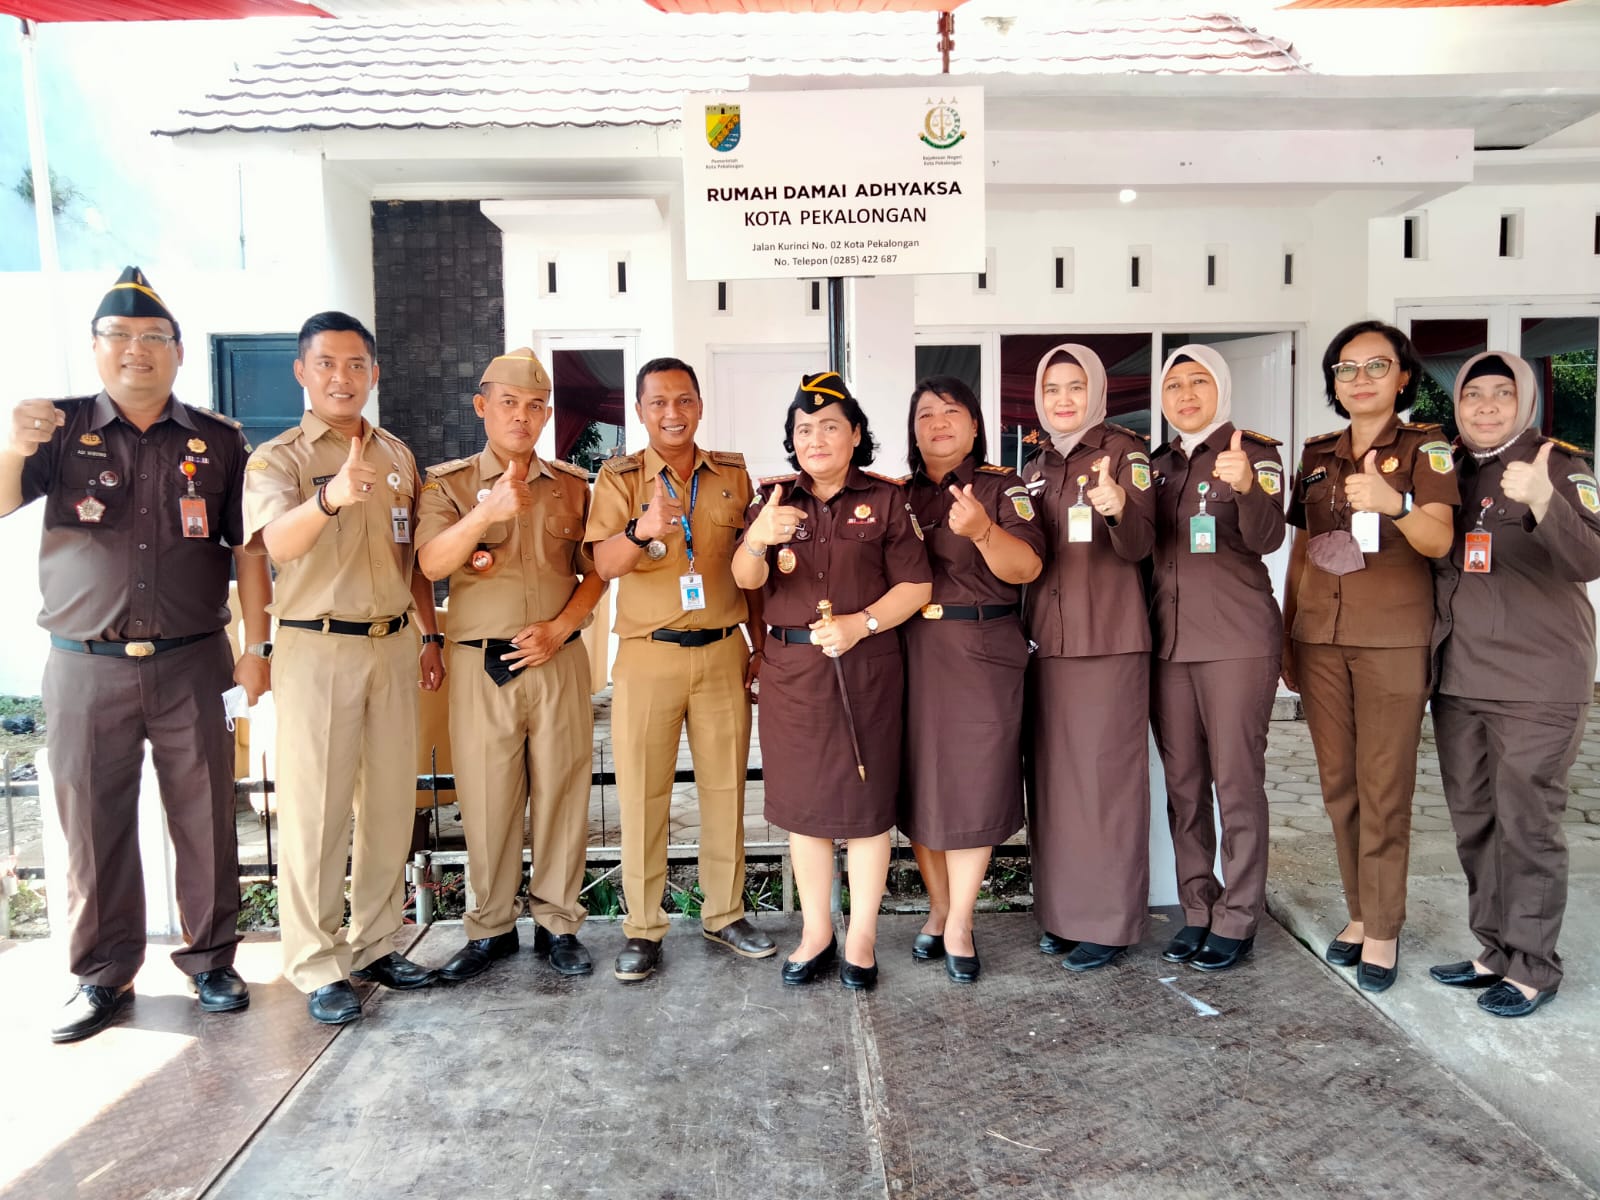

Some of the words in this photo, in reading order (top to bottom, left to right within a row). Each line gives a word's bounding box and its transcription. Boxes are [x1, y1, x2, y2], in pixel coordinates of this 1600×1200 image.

[717, 163, 745, 171] Pekalongan
[706, 186, 778, 202] RUMAH
[783, 184, 847, 200] DAMAI
[854, 181, 963, 198] ADHYAKSA
[744, 210, 792, 226] KOTA
[800, 207, 927, 225] PEKALONGAN
[751, 242, 776, 252] Jalan
[777, 241, 810, 251] Kurinci
[811, 240, 829, 250] No.
[830, 240, 842, 250] 02
[843, 239, 865, 250] Kota
[867, 238, 920, 250] Pekalongan
[773, 257, 790, 267] No.
[792, 256, 828, 267] Telepon
[829, 255, 860, 266] (0285)
[861, 254, 879, 264] 422
[880, 254, 898, 264] 687
